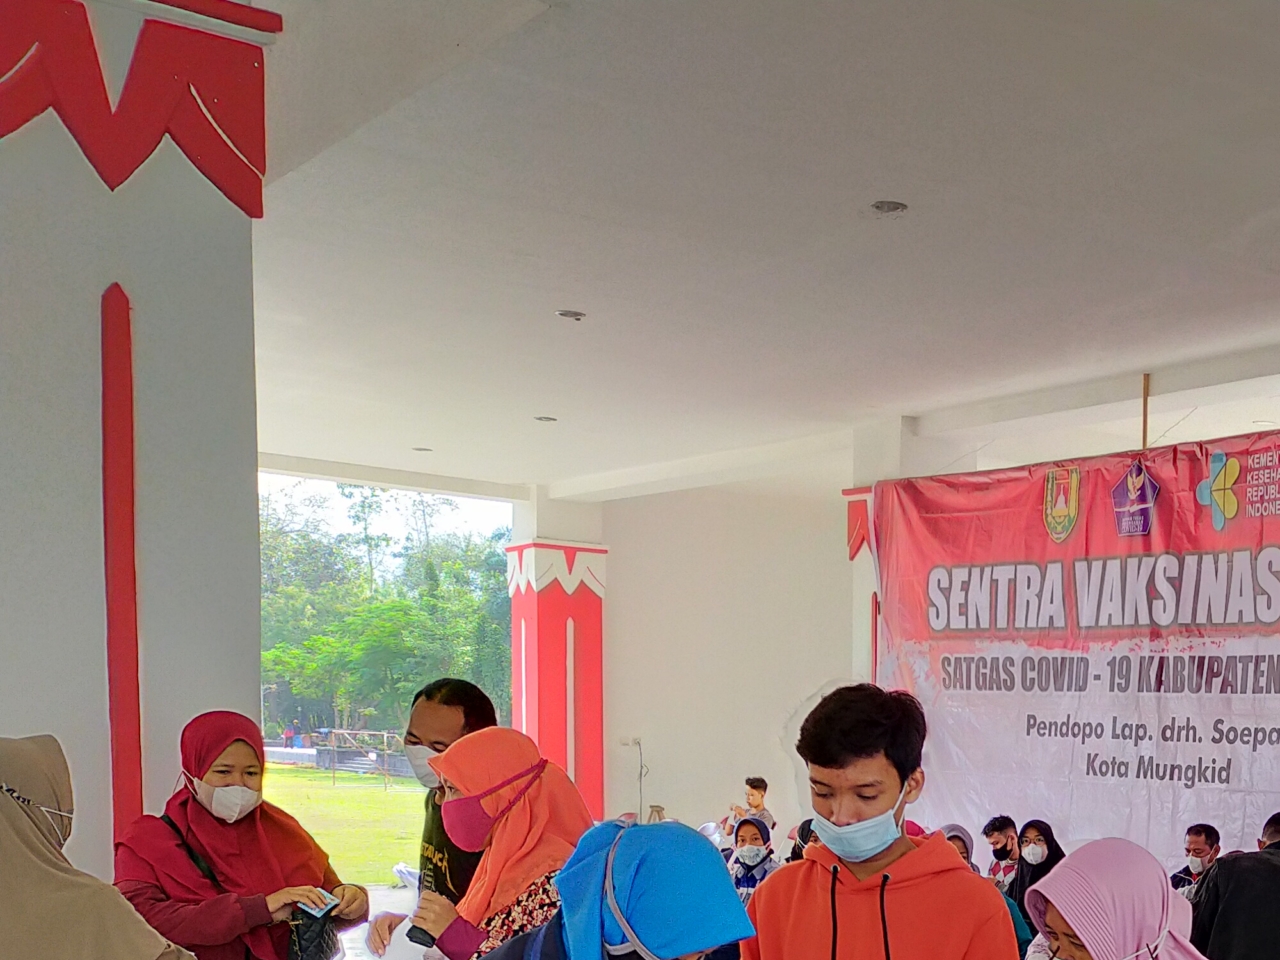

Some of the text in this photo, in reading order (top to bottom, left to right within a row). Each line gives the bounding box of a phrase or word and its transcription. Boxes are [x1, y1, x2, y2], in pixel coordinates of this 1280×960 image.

[928, 561, 1067, 631] SENTRA
[941, 655, 1015, 692] SATGAS
[1107, 655, 1131, 693] 19
[1026, 714, 1104, 744] Pendopo
[1111, 716, 1153, 747] Lap.
[1161, 717, 1203, 743] drh.
[1085, 753, 1232, 789] Kota Mungkid
